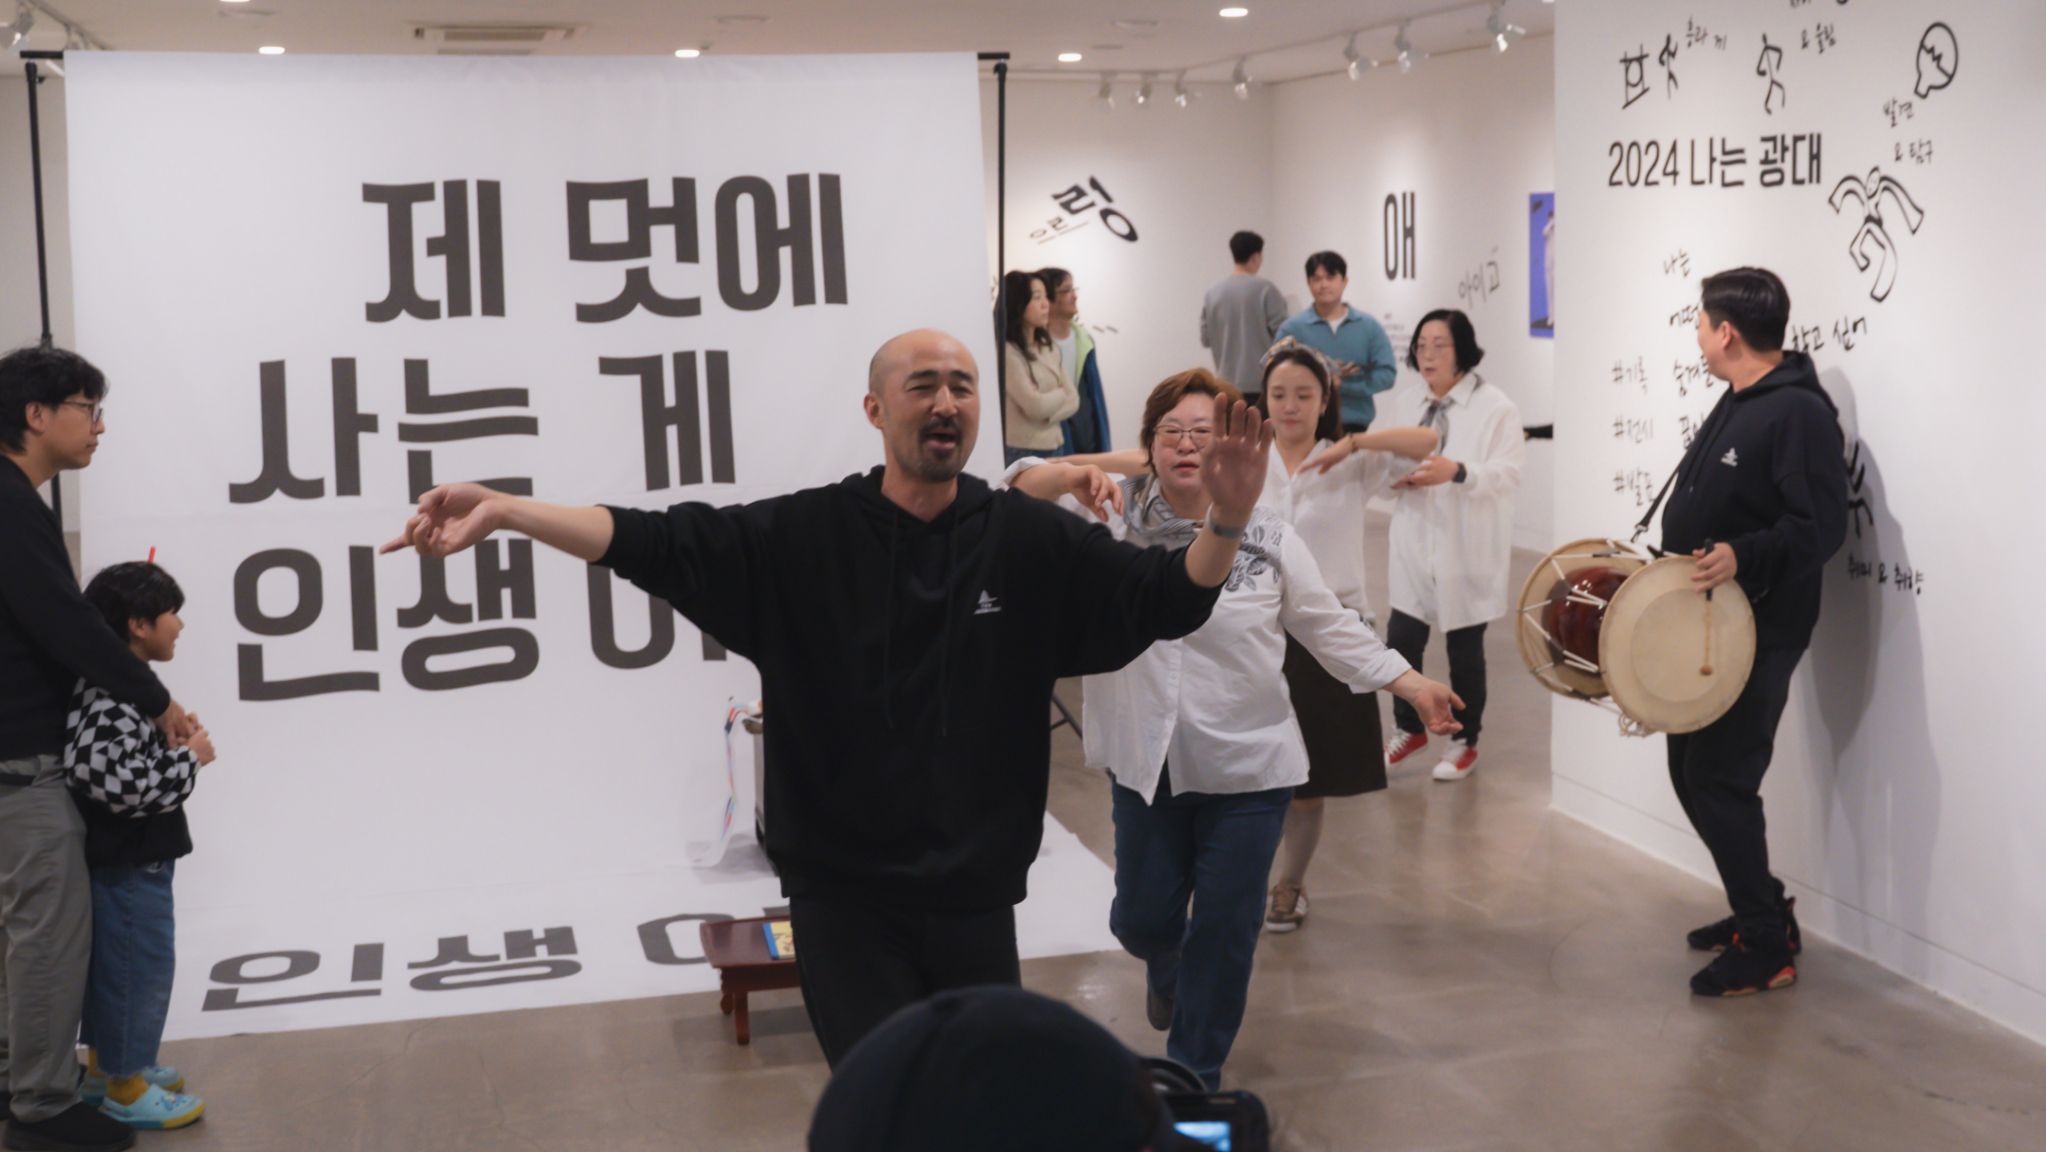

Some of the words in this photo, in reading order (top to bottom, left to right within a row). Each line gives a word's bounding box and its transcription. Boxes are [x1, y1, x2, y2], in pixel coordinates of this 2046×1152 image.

[1608, 139, 1679, 187] 2024
[1690, 136, 1748, 188] 나는
[1758, 132, 1822, 188] 광대
[362, 179, 506, 324] 제
[565, 172, 849, 324] 멋에
[1457, 260, 1501, 310] 아이고
[1663, 248, 1691, 278] 나는
[229, 356, 539, 505] 사는
[598, 349, 736, 492] 게
[233, 538, 540, 701] 인생
[201, 925, 582, 1012] 인생
